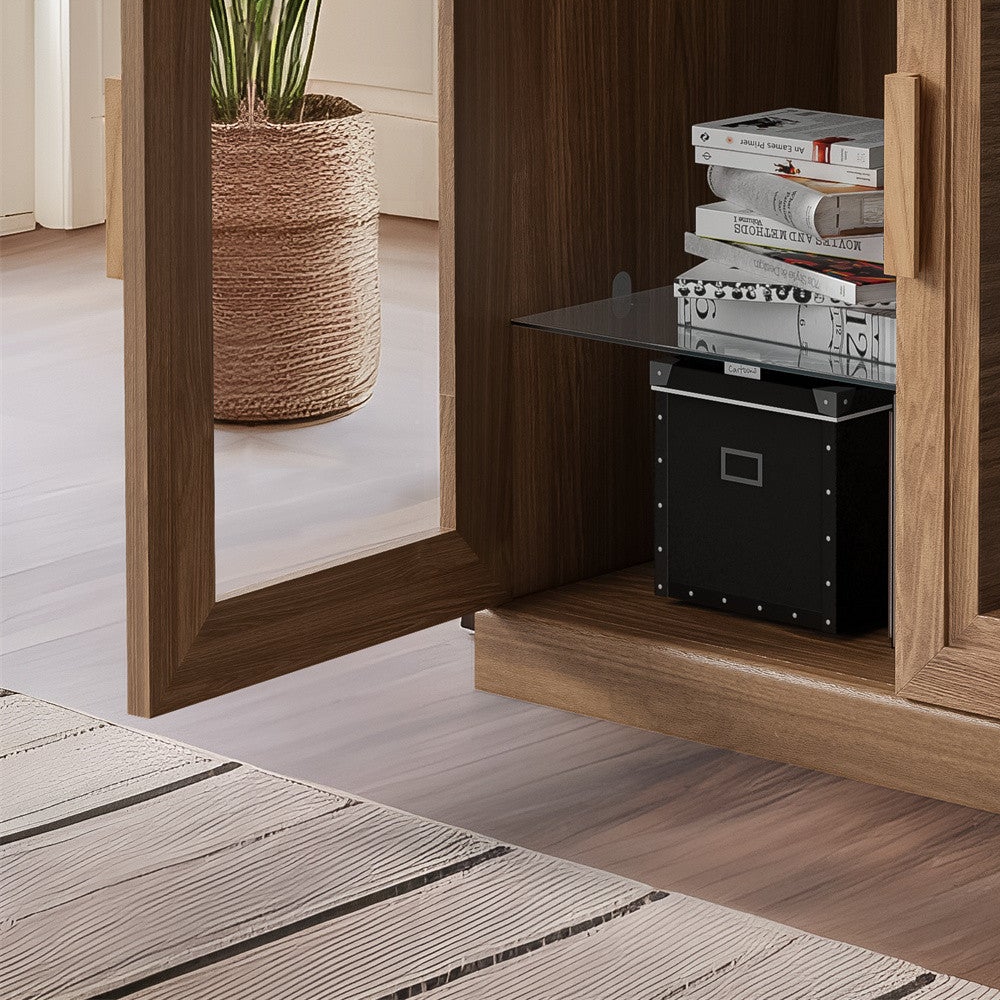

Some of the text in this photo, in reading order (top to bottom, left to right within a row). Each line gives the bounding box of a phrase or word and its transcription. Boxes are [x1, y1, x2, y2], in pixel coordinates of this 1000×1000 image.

[740, 138, 805, 155] An Eames Primer
[743, 217, 764, 228] Volume
[734, 224, 787, 240] METHODS
[789, 231, 812, 243] AND
[846, 312, 868, 357] 12
